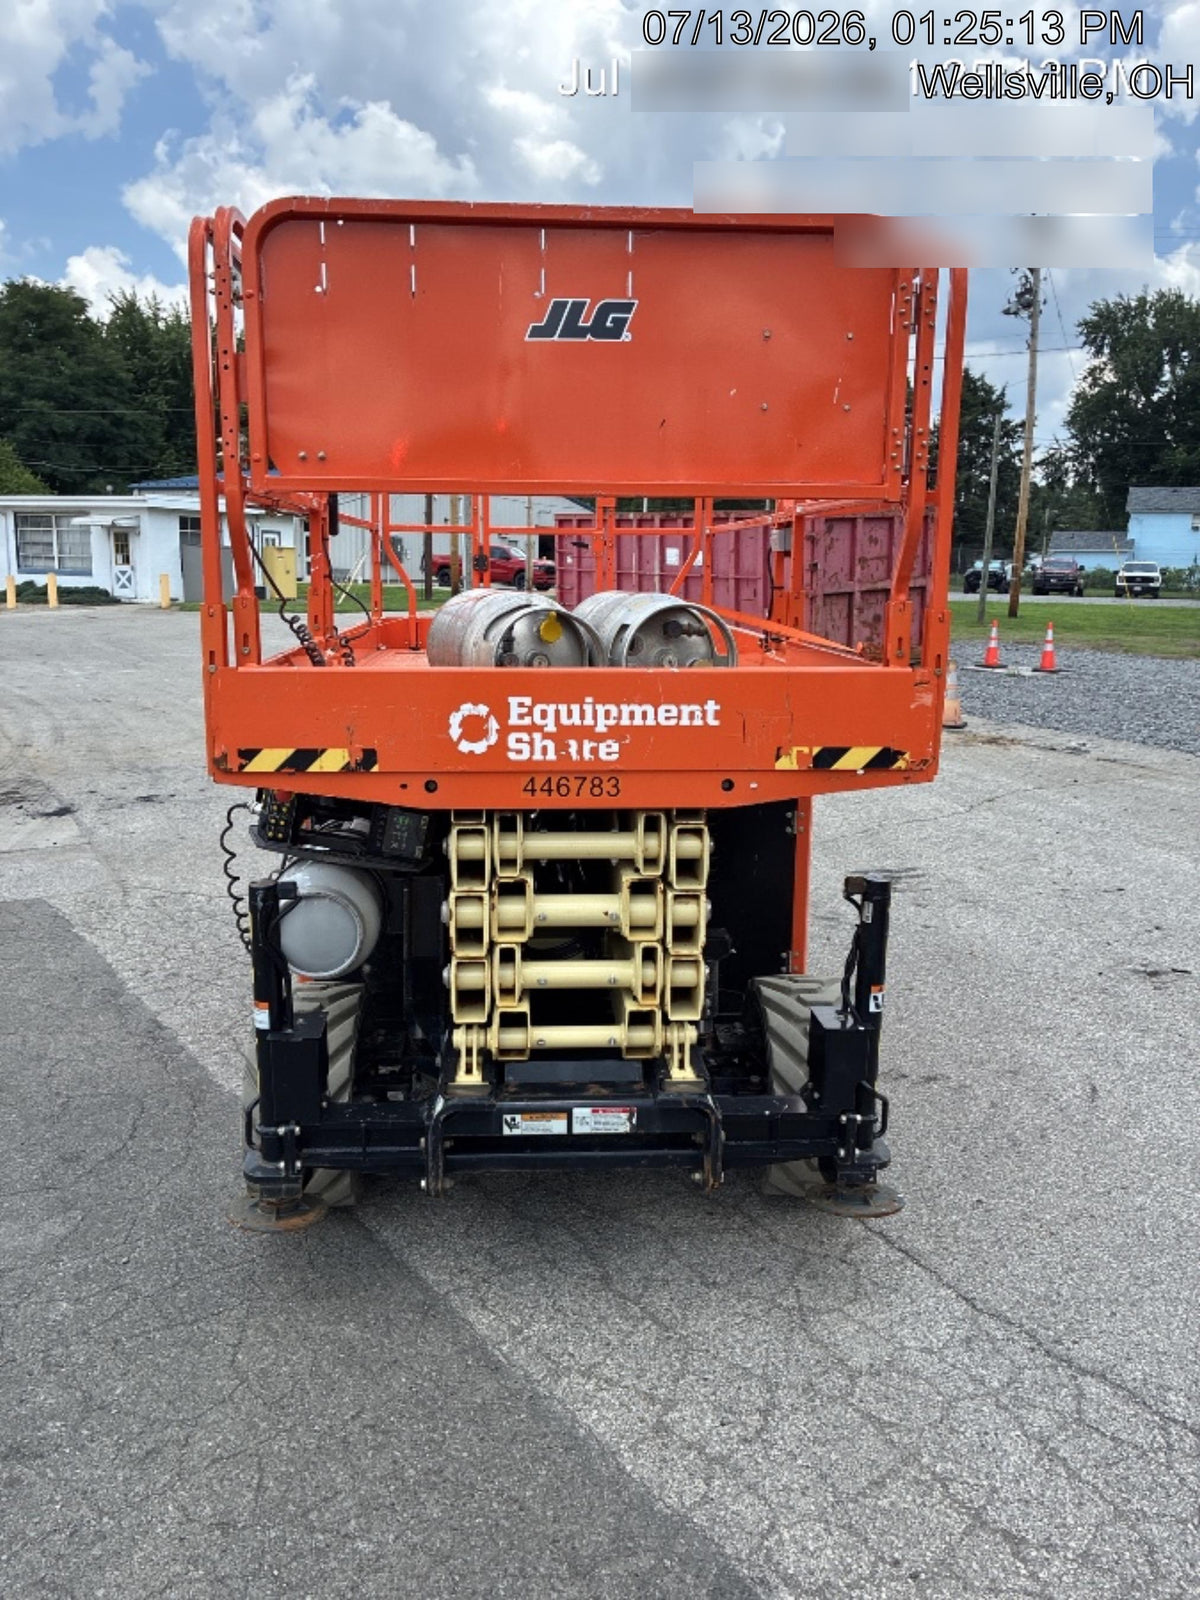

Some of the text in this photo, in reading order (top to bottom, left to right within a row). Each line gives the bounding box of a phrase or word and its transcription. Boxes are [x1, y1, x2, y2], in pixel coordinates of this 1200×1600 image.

[524, 298, 639, 342] JLG
[507, 696, 721, 733] Equipment
[522, 776, 621, 798] 446783
